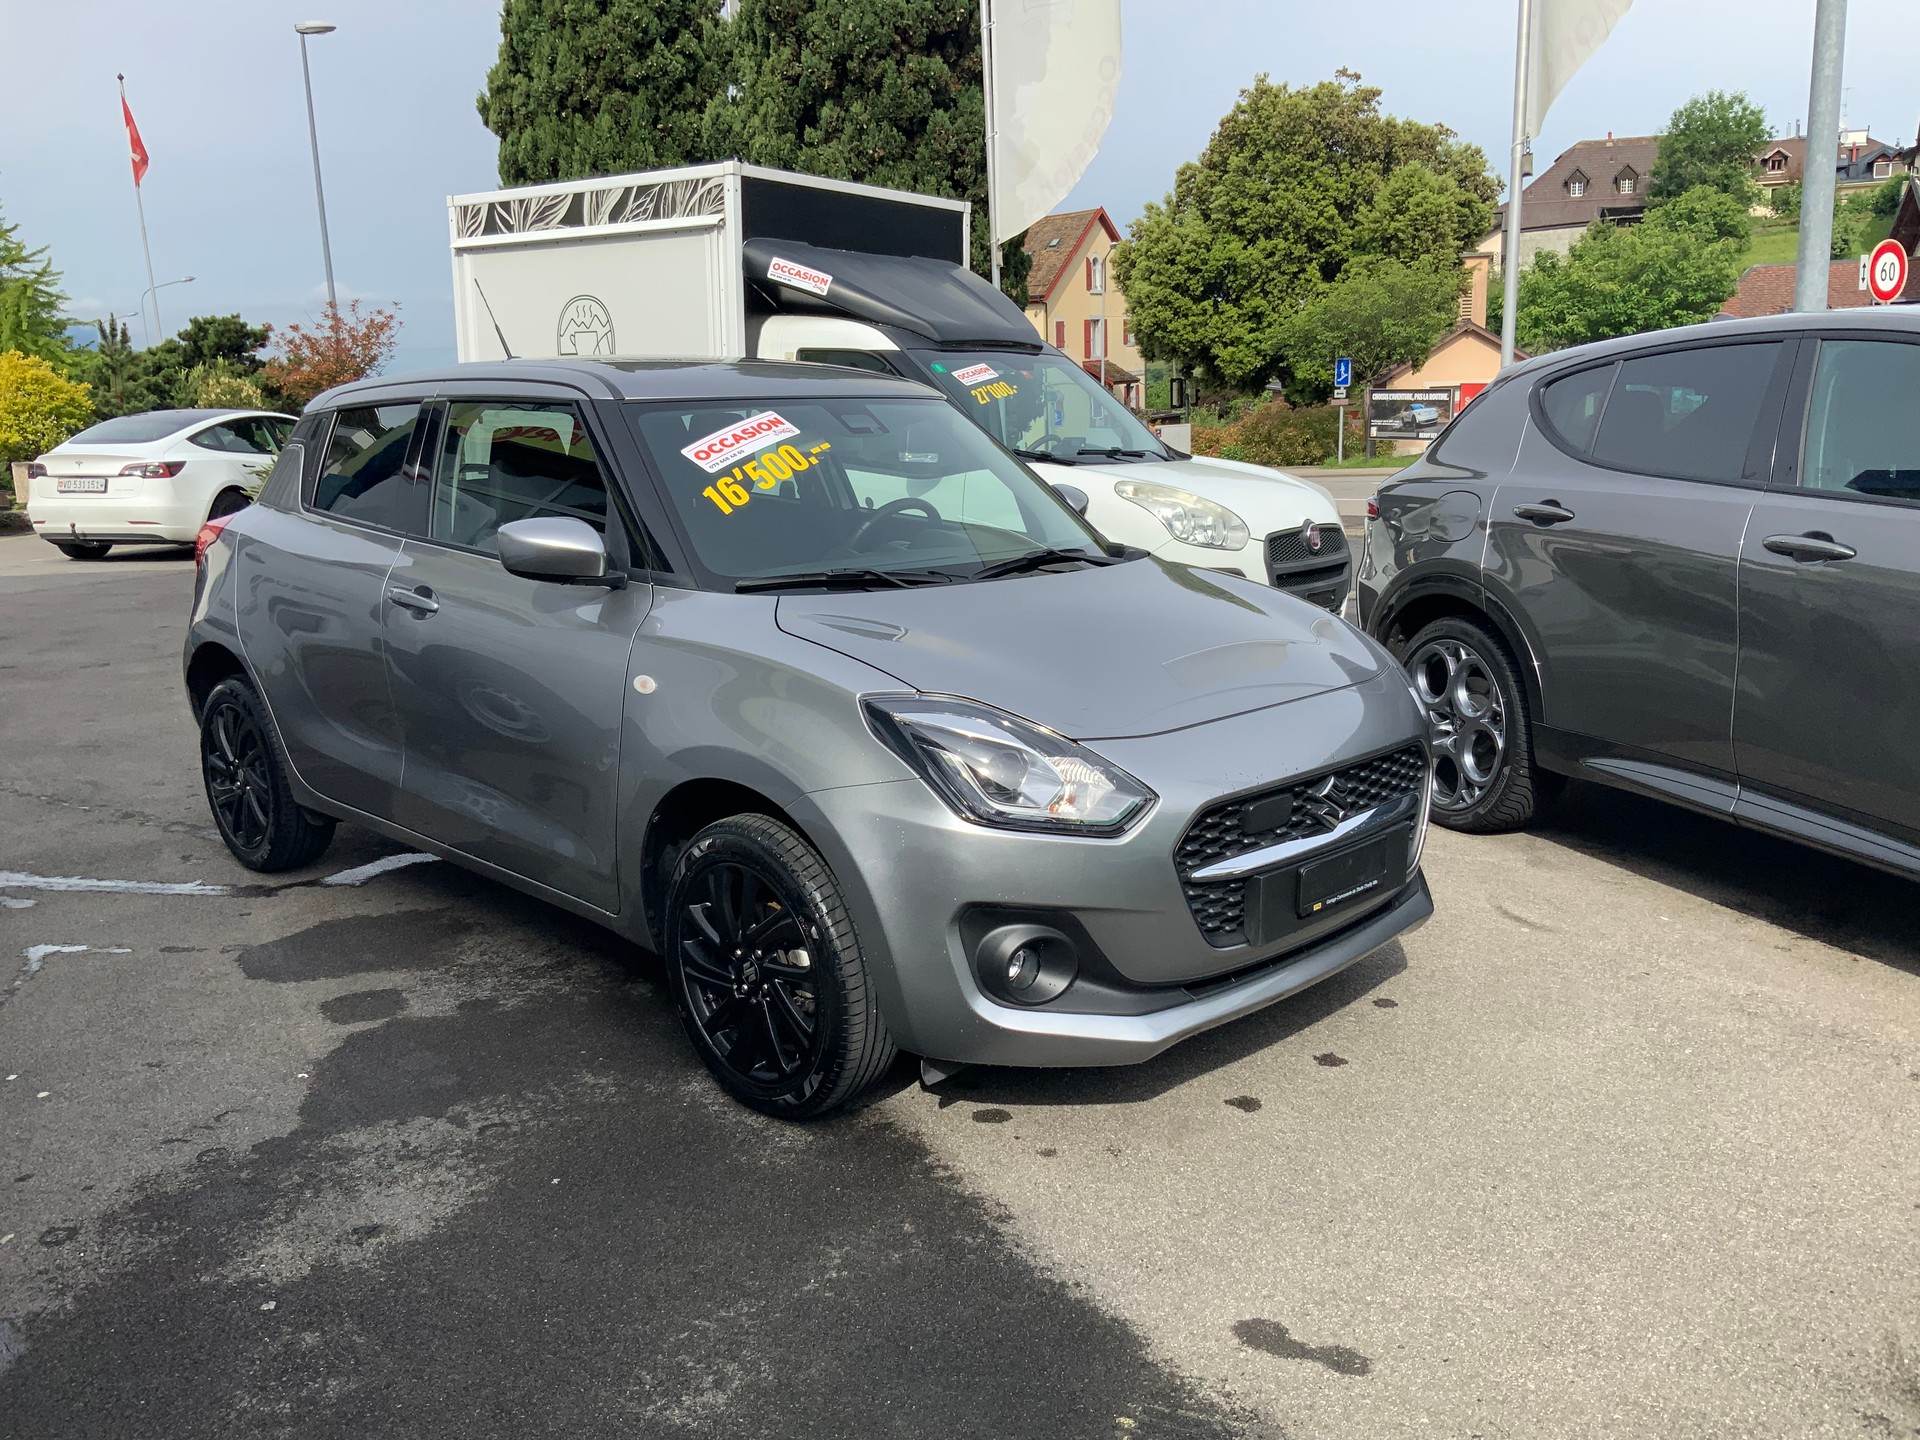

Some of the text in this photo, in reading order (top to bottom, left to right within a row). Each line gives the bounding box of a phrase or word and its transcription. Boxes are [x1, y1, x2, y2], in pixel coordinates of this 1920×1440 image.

[772, 262, 829, 287] OCCASION
[1880, 261, 1896, 282] 60
[957, 366, 992, 380] OCCASION
[694, 416, 786, 461] OCCASION
